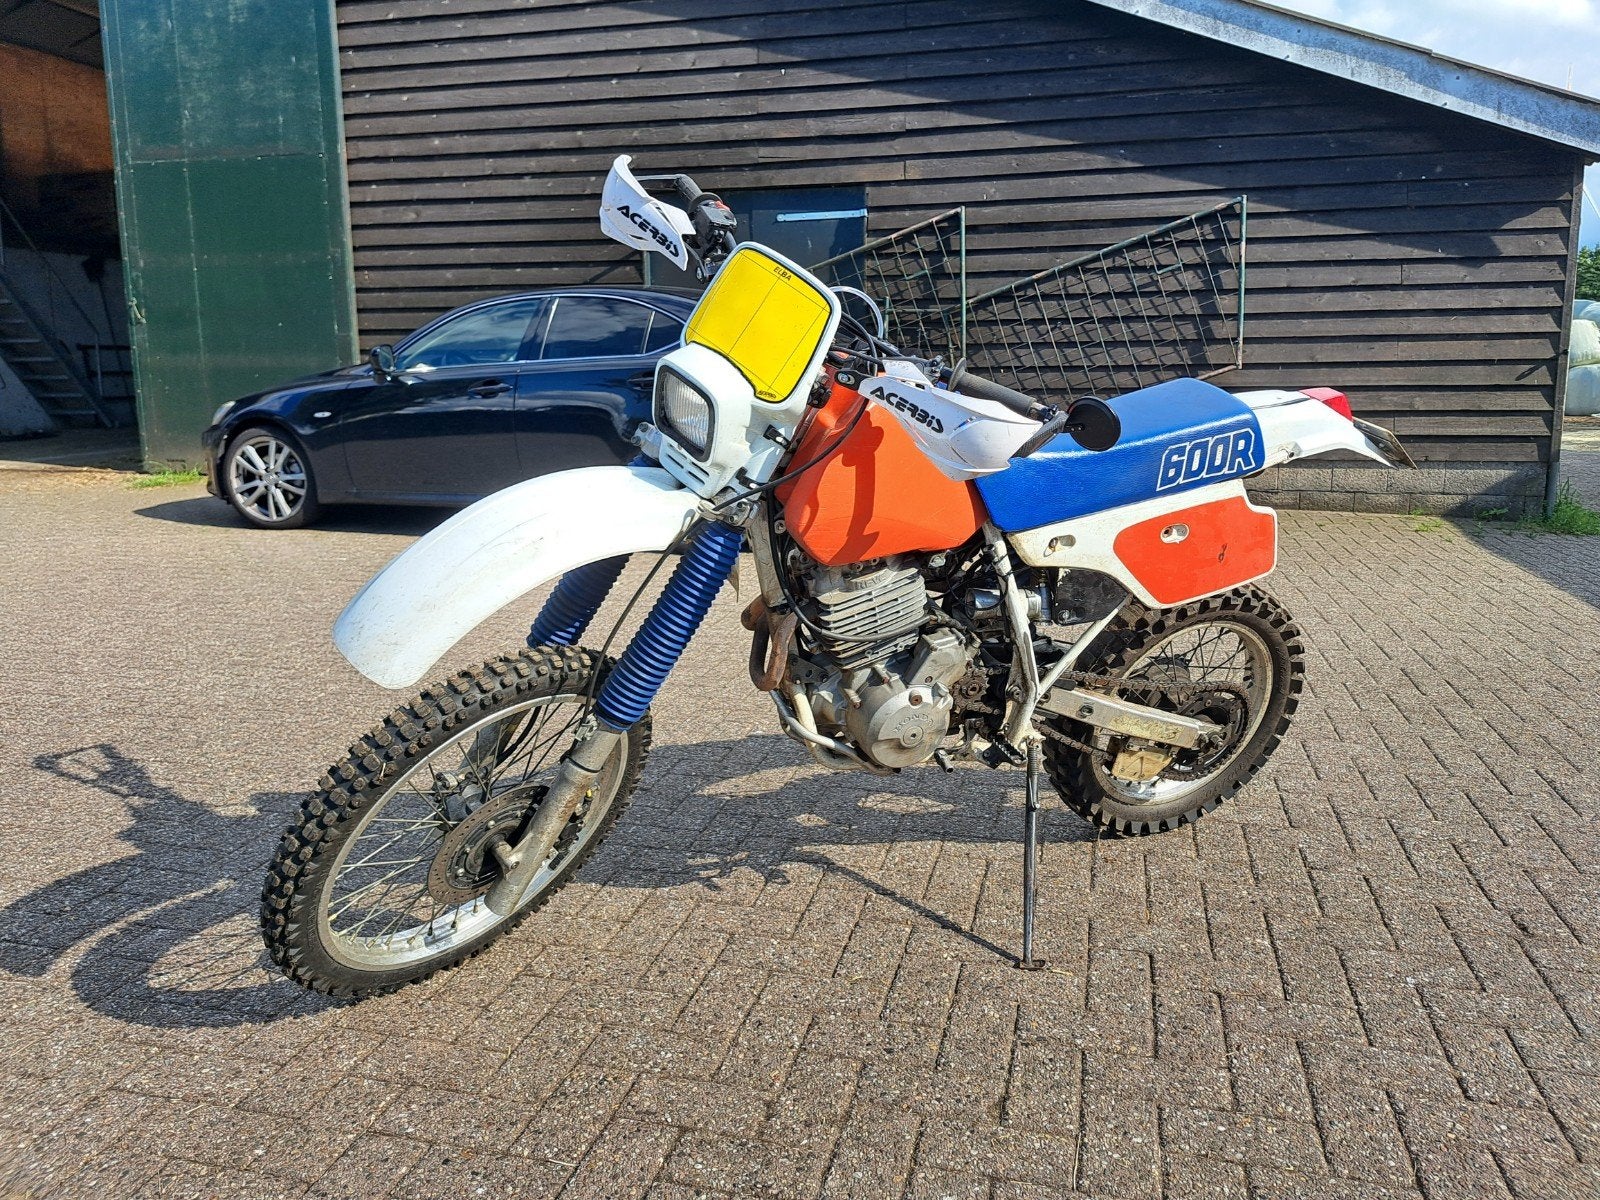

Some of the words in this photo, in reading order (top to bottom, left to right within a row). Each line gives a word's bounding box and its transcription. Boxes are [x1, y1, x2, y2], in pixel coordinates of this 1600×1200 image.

[617, 205, 680, 258] ACERBIS
[773, 266, 792, 281] ELBA
[870, 386, 944, 434] ACERBIS
[1156, 427, 1256, 492] 600R
